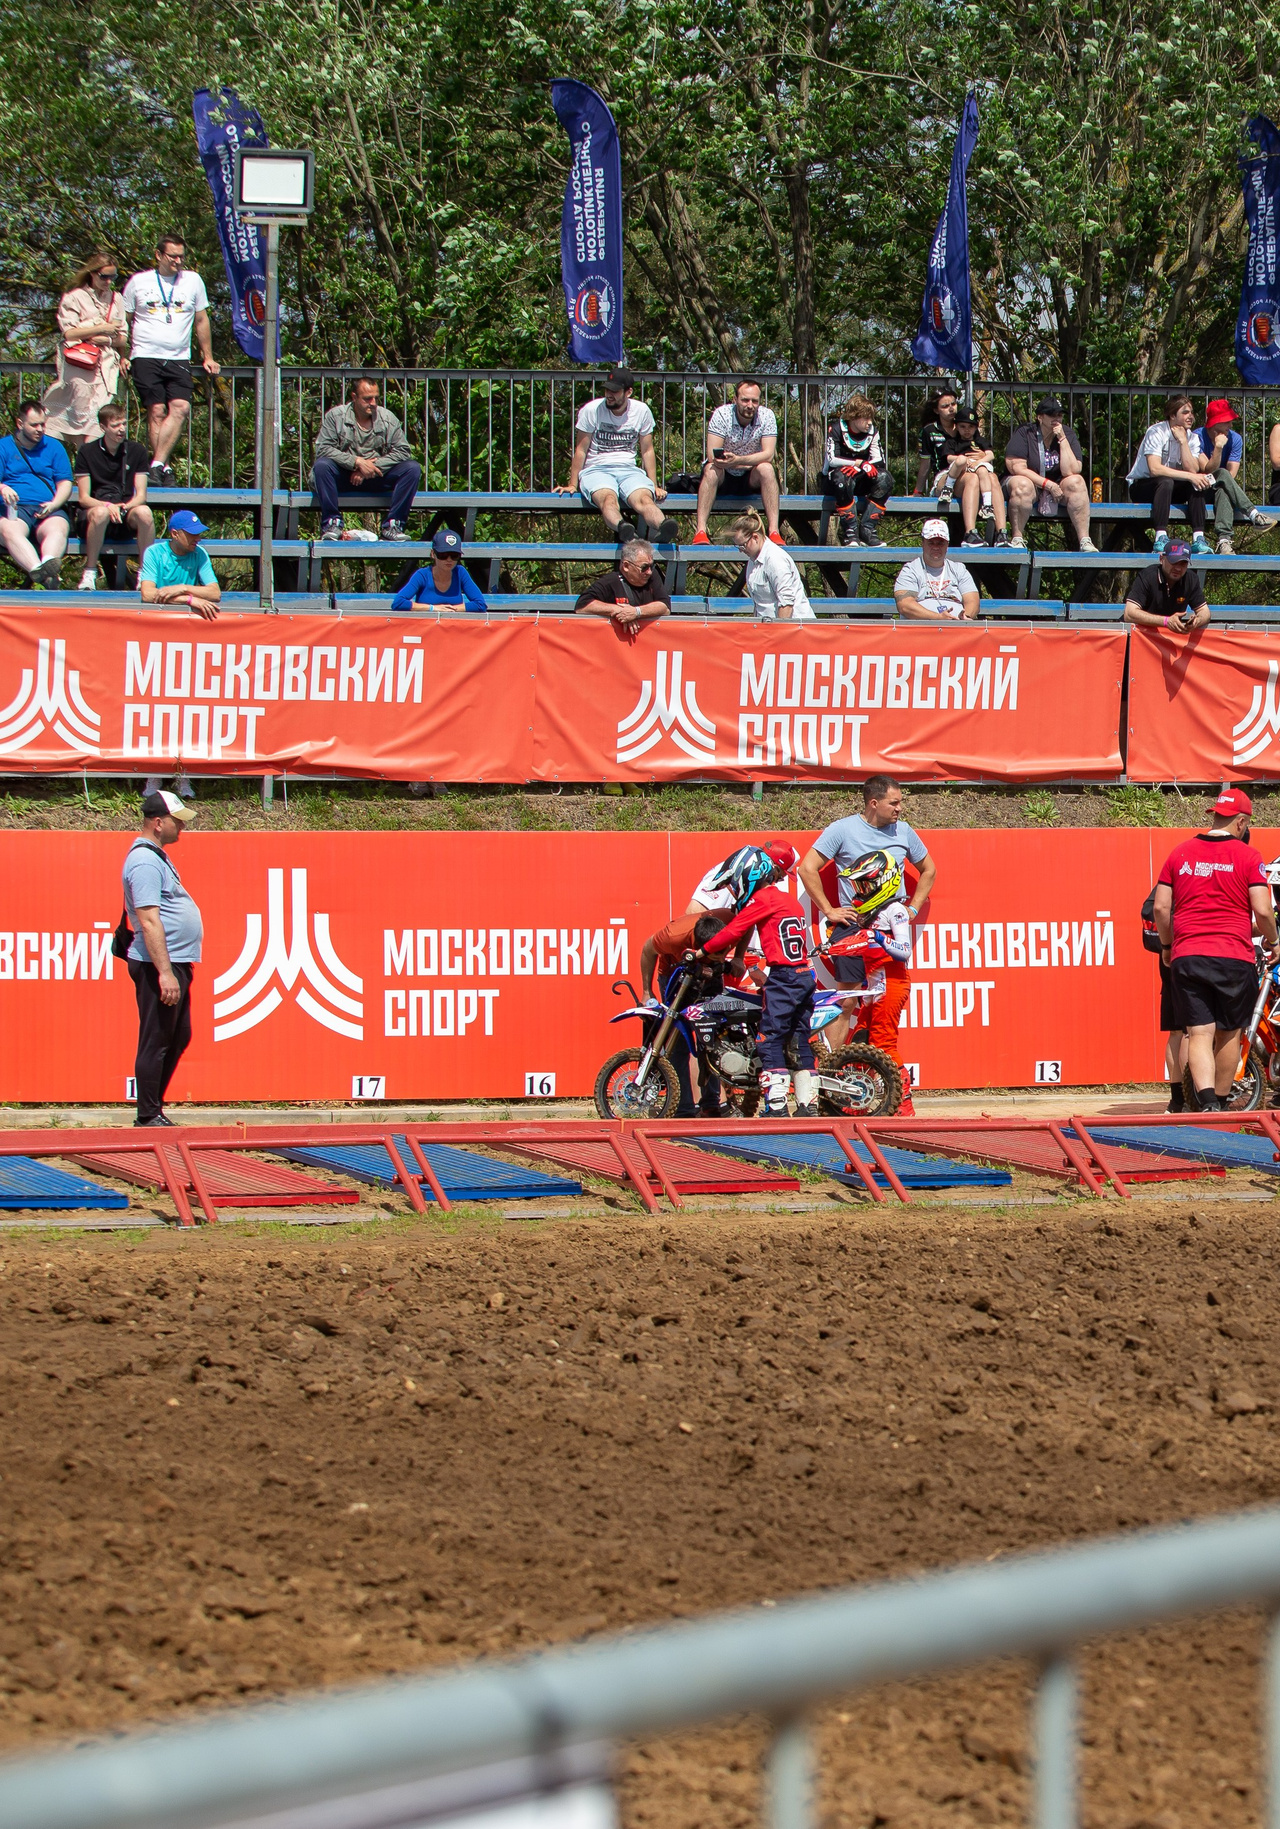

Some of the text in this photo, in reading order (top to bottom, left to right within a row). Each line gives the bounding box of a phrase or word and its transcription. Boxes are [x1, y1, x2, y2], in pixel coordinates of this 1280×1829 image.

[123, 636, 425, 703] МОСКОВСКИЙ
[739, 645, 1020, 710] МОСКОВСКИЙ
[122, 703, 266, 760] СПОРТ
[738, 713, 869, 767] СПОРТ
[876, 867, 898, 885] 100%
[1194, 869, 1214, 877] СПОРТ
[1195, 862, 1235, 873] МОСКОВСКИЙ
[0, 921, 114, 980] ВСКИЙ
[383, 918, 629, 976] МОСКОВСКИЙ
[383, 989, 500, 1037] СПОРТ
[128, 1078, 136, 1098] 1
[355, 1076, 382, 1097] 17
[526, 1074, 554, 1095] 16
[1037, 1062, 1060, 1082] 13
